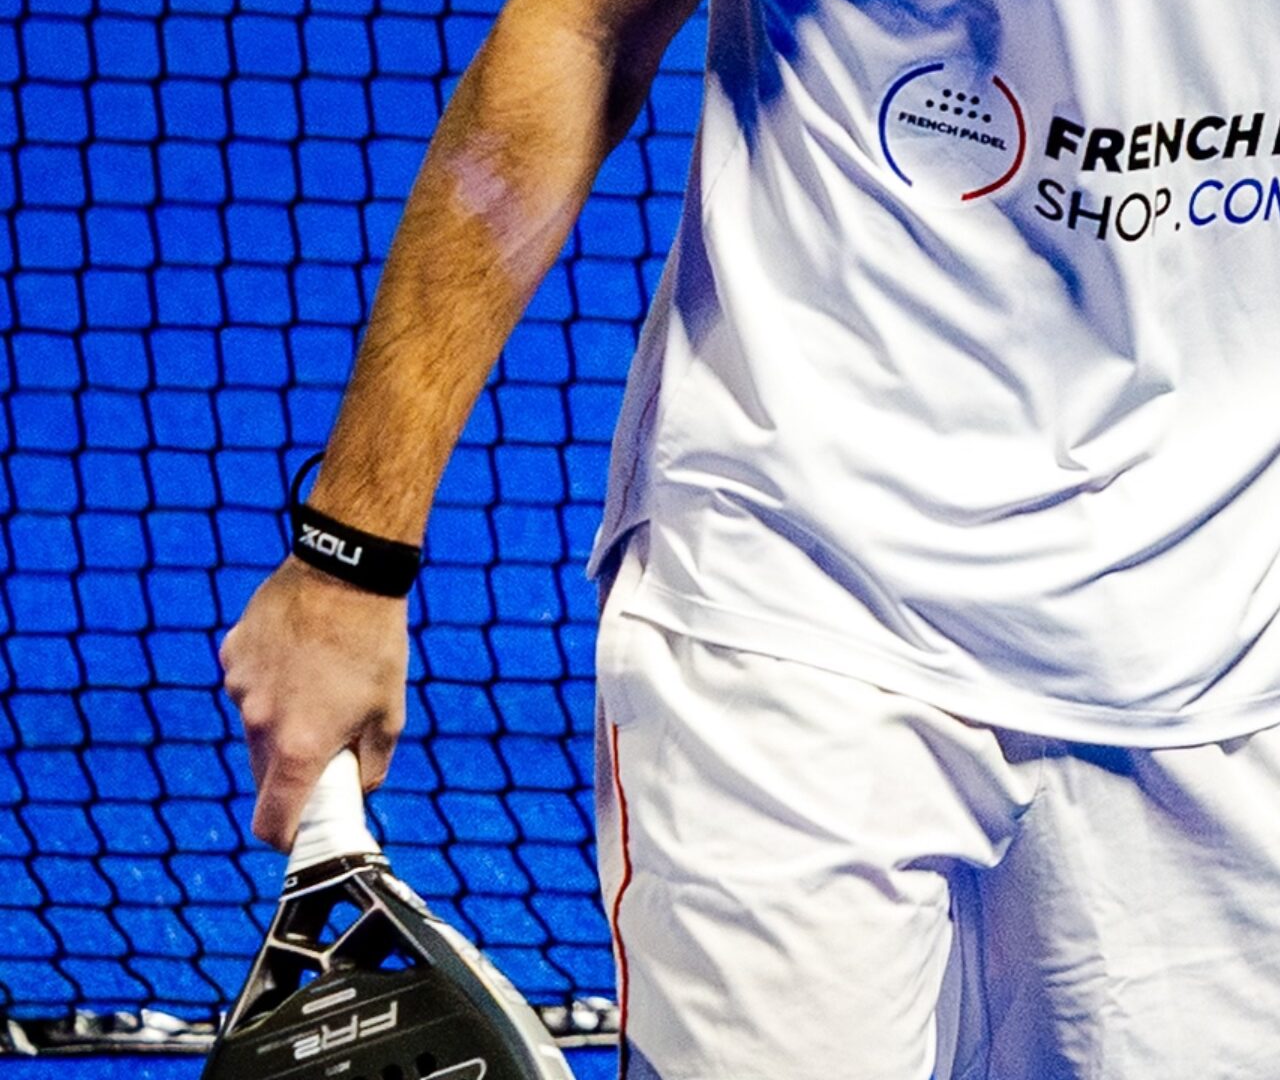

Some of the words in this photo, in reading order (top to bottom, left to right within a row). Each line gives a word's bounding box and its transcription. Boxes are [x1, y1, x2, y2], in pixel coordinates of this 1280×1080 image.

[897, 111, 959, 138] FRENCH
[960, 126, 1008, 152] PADEL
[1045, 112, 1265, 174] FRENCH
